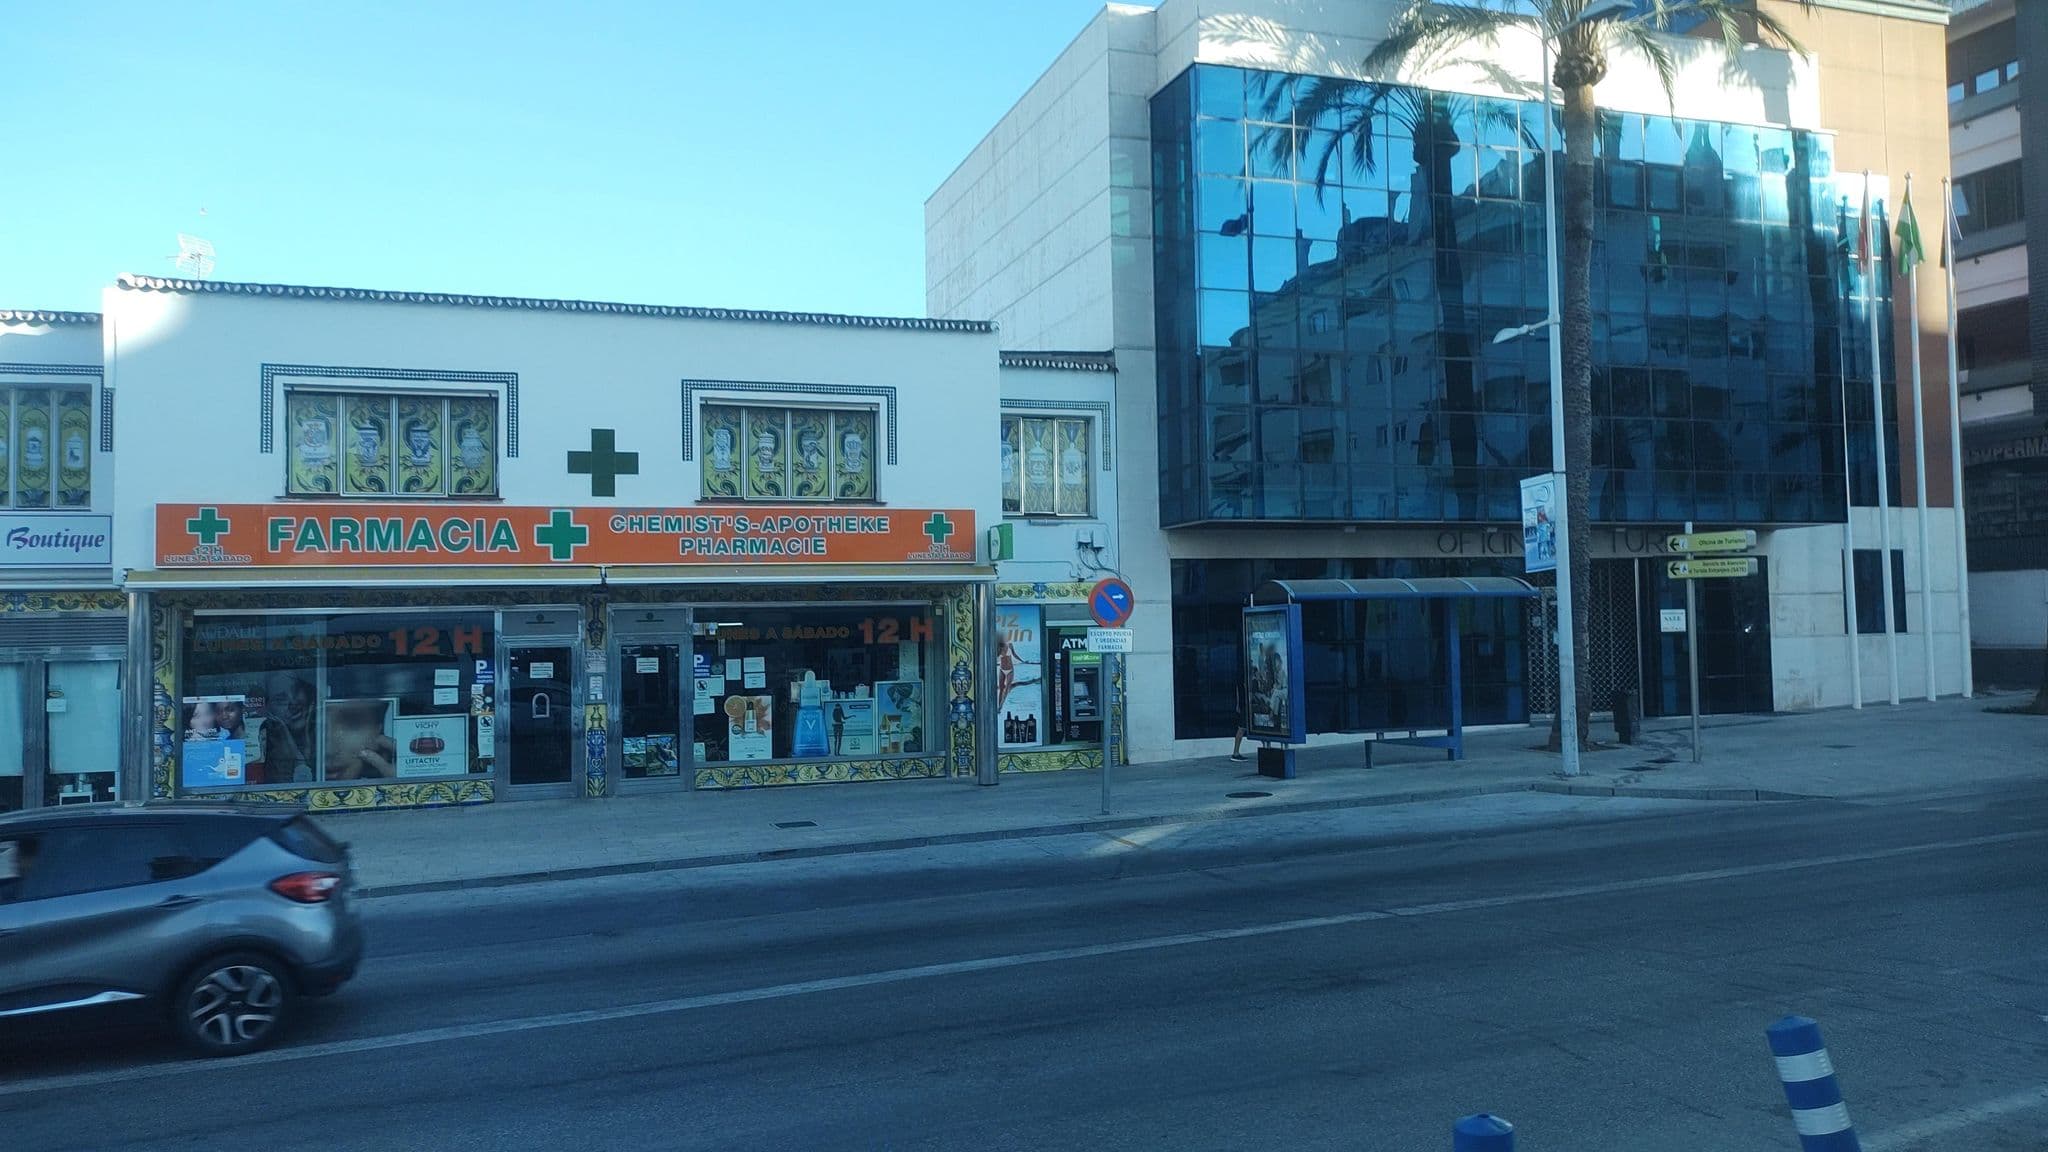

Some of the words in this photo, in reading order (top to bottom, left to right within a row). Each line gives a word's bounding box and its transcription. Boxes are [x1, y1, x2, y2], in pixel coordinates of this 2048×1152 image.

[609, 514, 890, 535] CHEMIST'S-APOTHEKE
[6, 526, 105, 553] Boutique
[267, 516, 520, 554] FARMACIA
[193, 545, 210, 556] 12
[211, 545, 224, 556] H
[678, 535, 827, 556] PHARMACIE
[858, 617, 900, 644] 12
[909, 616, 935, 642] H
[388, 626, 441, 656] 12
[453, 624, 483, 654] H
[1061, 637, 1088, 650] ATM
[475, 659, 488, 674] P
[693, 654, 704, 668] P
[415, 721, 440, 730] VICHY
[405, 757, 441, 765] LIFTACTIV
